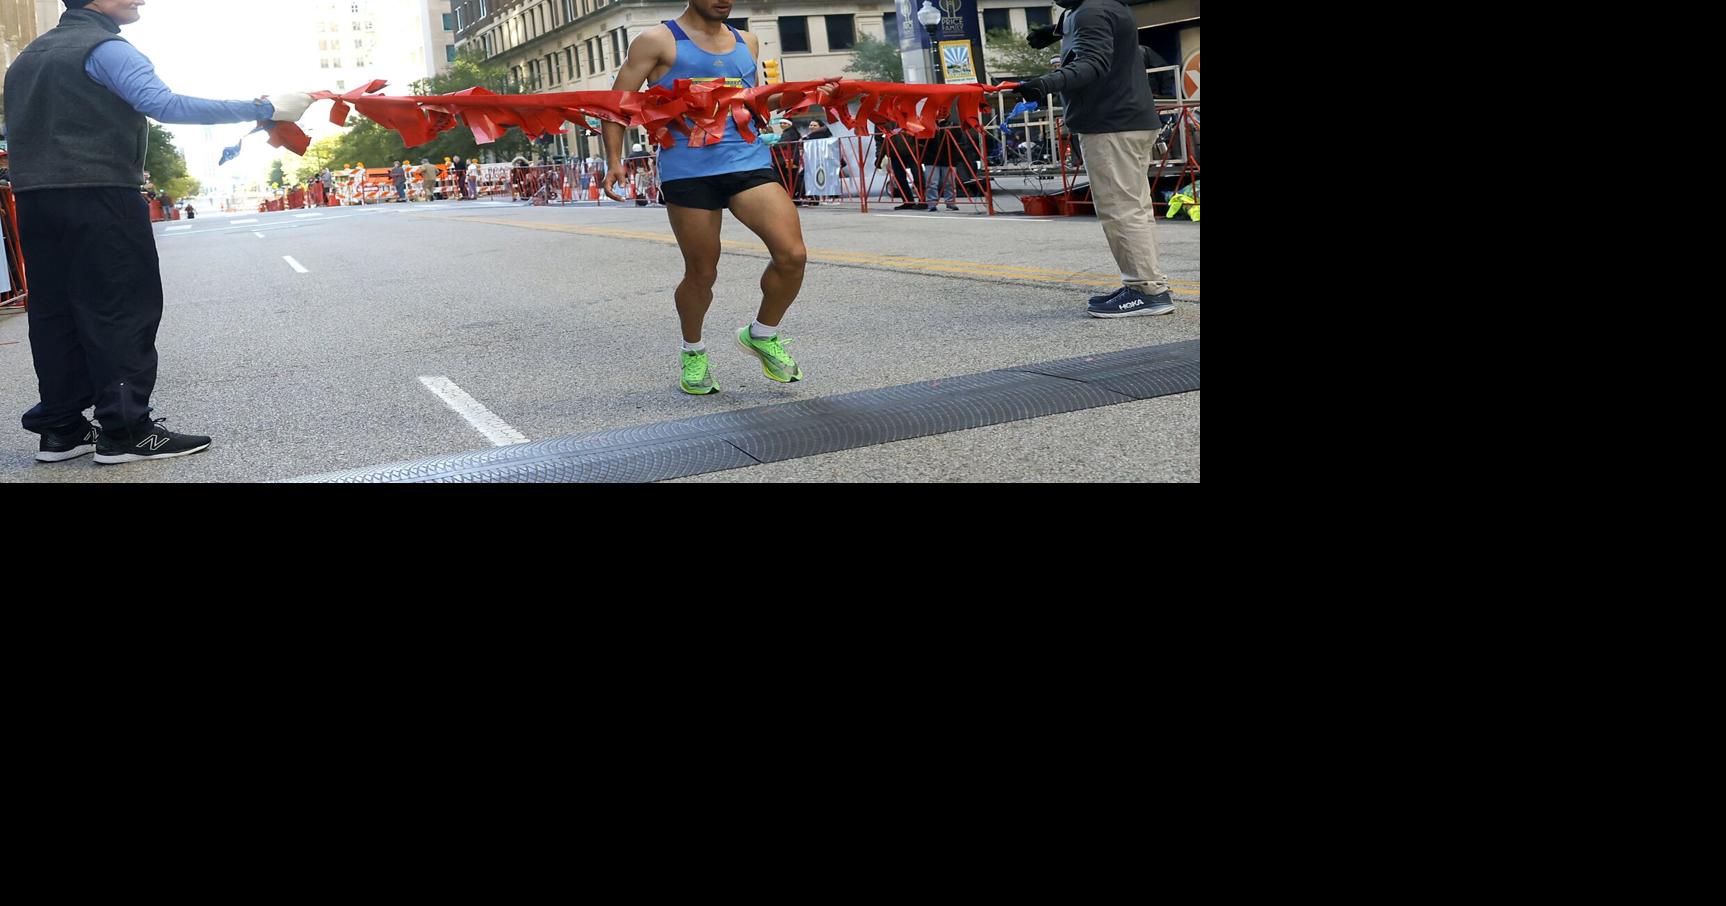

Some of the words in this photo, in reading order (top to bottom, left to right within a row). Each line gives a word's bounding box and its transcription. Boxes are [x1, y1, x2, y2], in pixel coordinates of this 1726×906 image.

[941, 16, 964, 25] PRICE
[941, 24, 964, 32] FAMILY
[1118, 299, 1144, 311] HOKA
